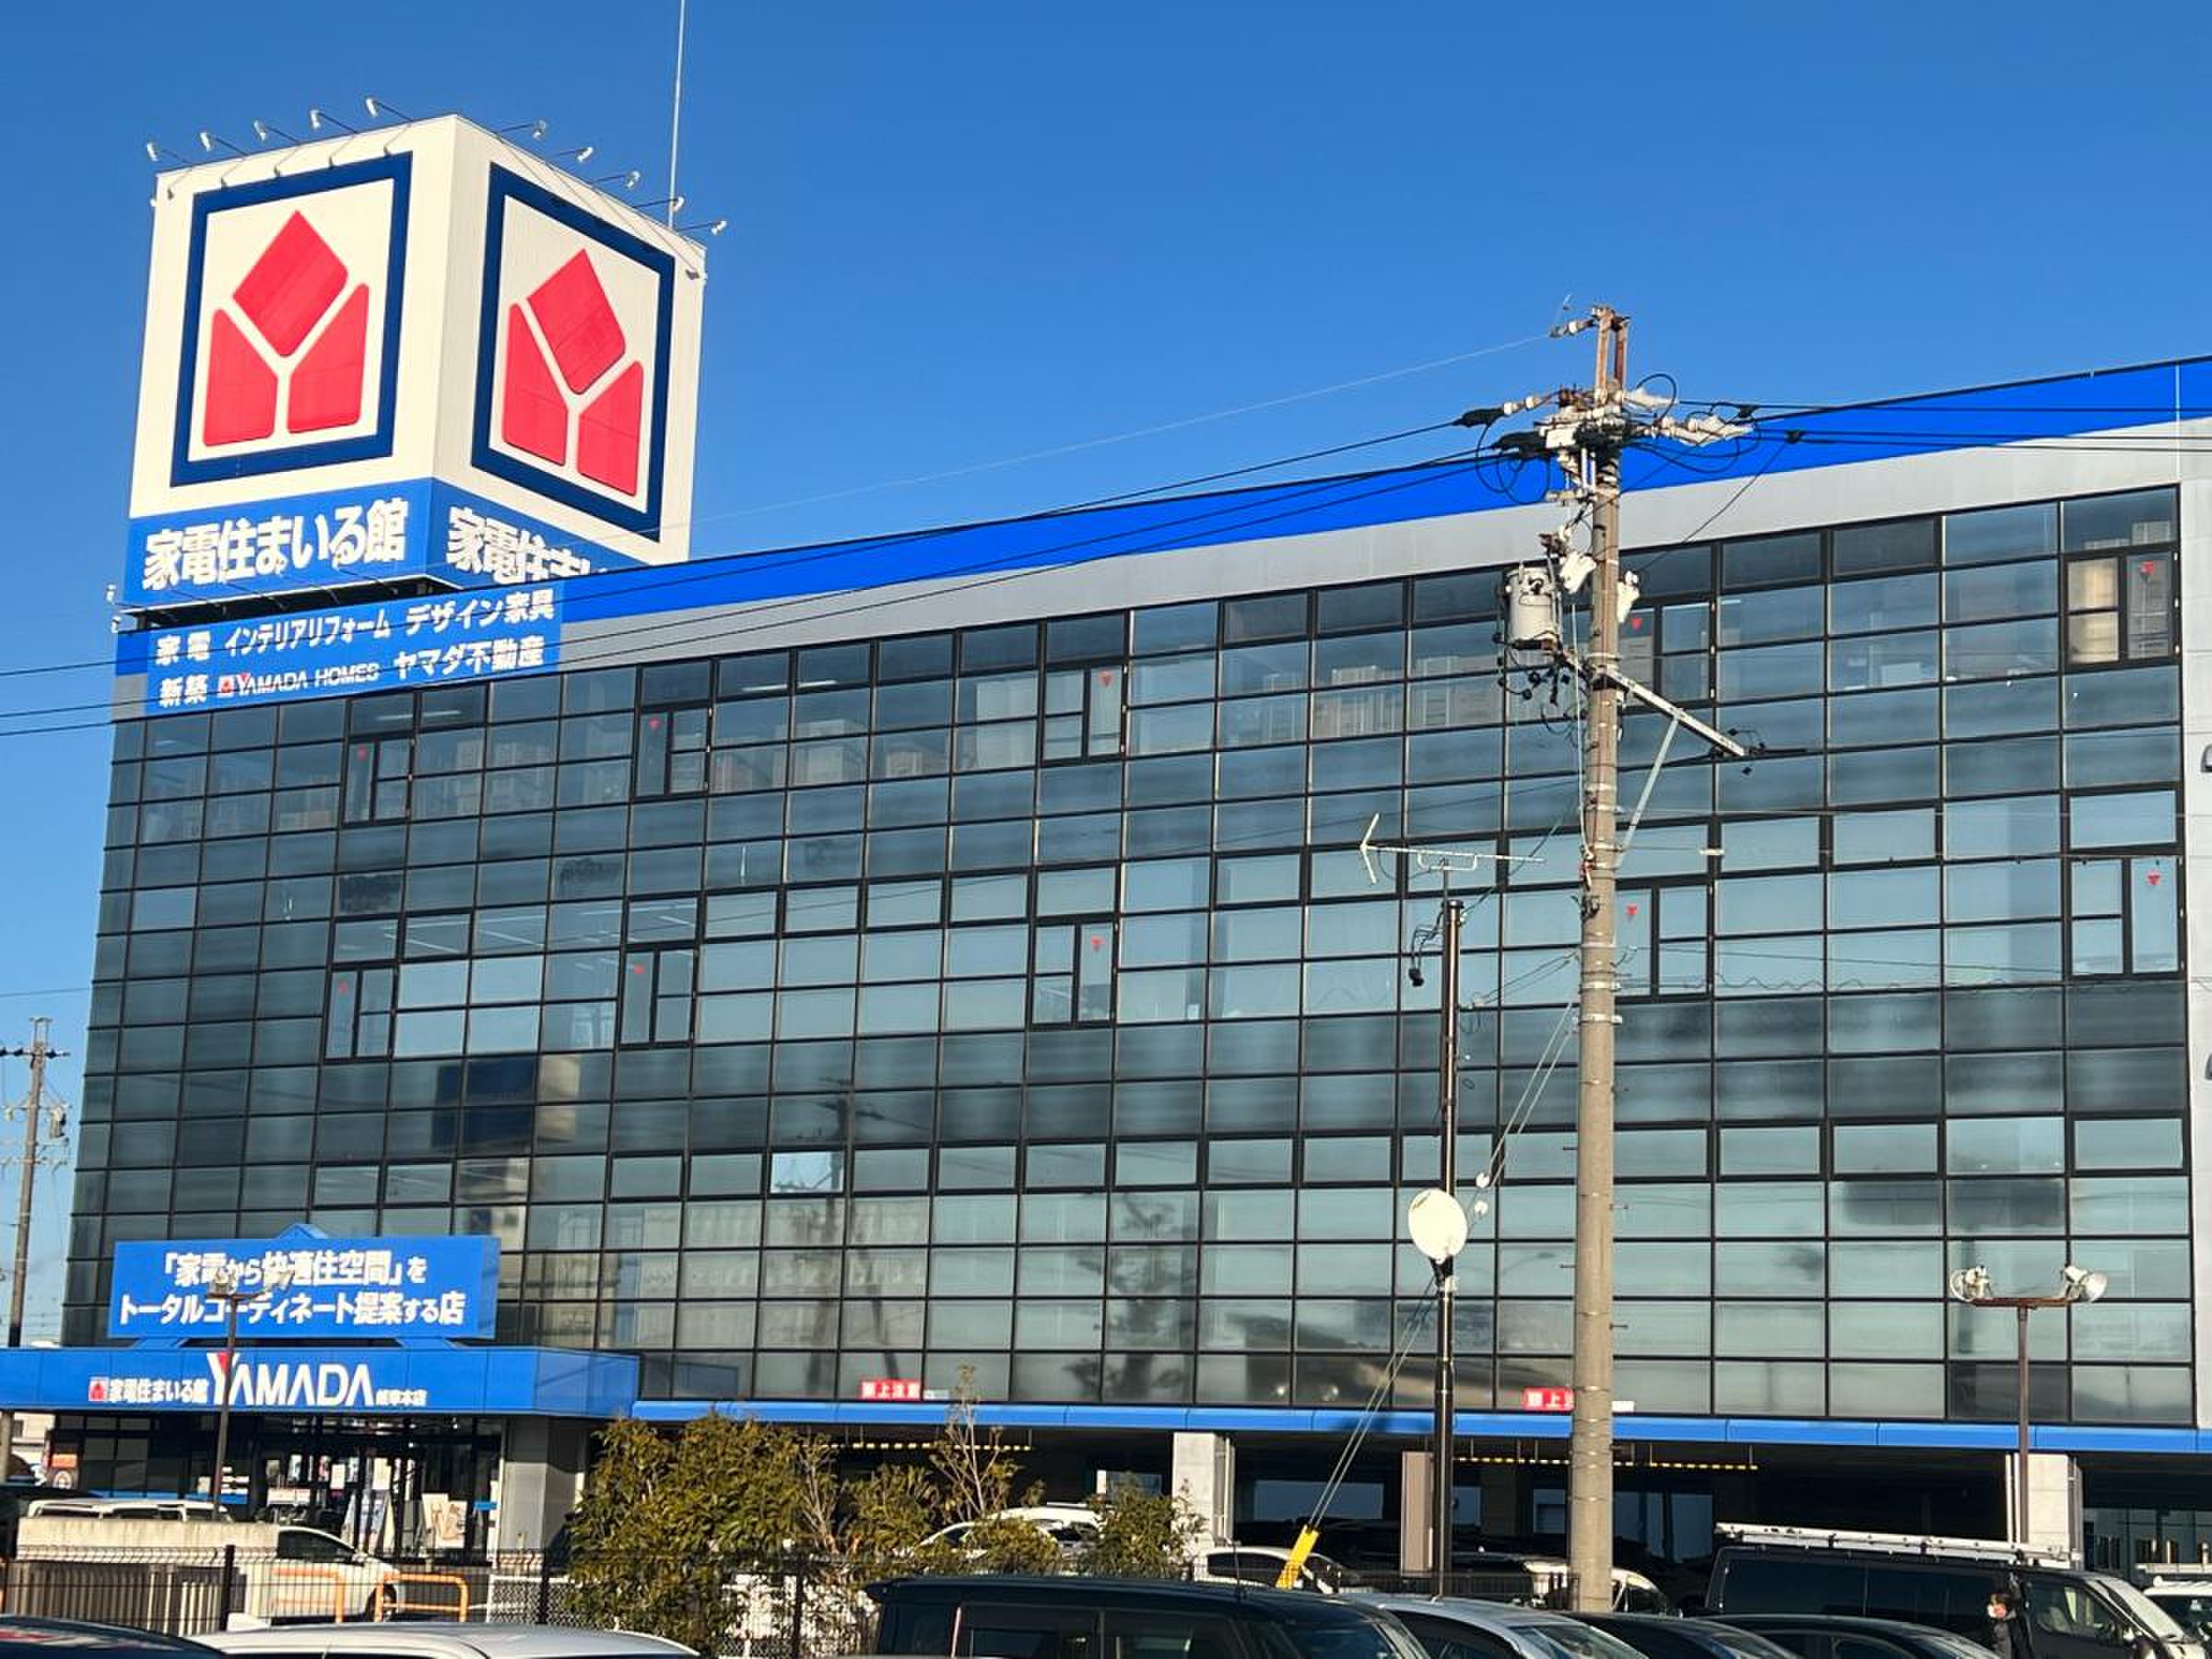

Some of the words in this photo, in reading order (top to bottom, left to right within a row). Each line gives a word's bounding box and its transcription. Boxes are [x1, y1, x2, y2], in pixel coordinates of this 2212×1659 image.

[142, 497, 408, 590] 家電住まいる館
[225, 608, 391, 657] インテリアリフォーム
[406, 588, 554, 636] デザイン家具
[236, 672, 308, 696] YAMADA
[314, 662, 381, 688] HOMES
[394, 635, 546, 680] ヤマダ不動産
[120, 1290, 466, 1325] トータルコーディネート提案する店
[108, 1378, 208, 1403] 家電住まいる館
[206, 1352, 374, 1406] YAMADA
